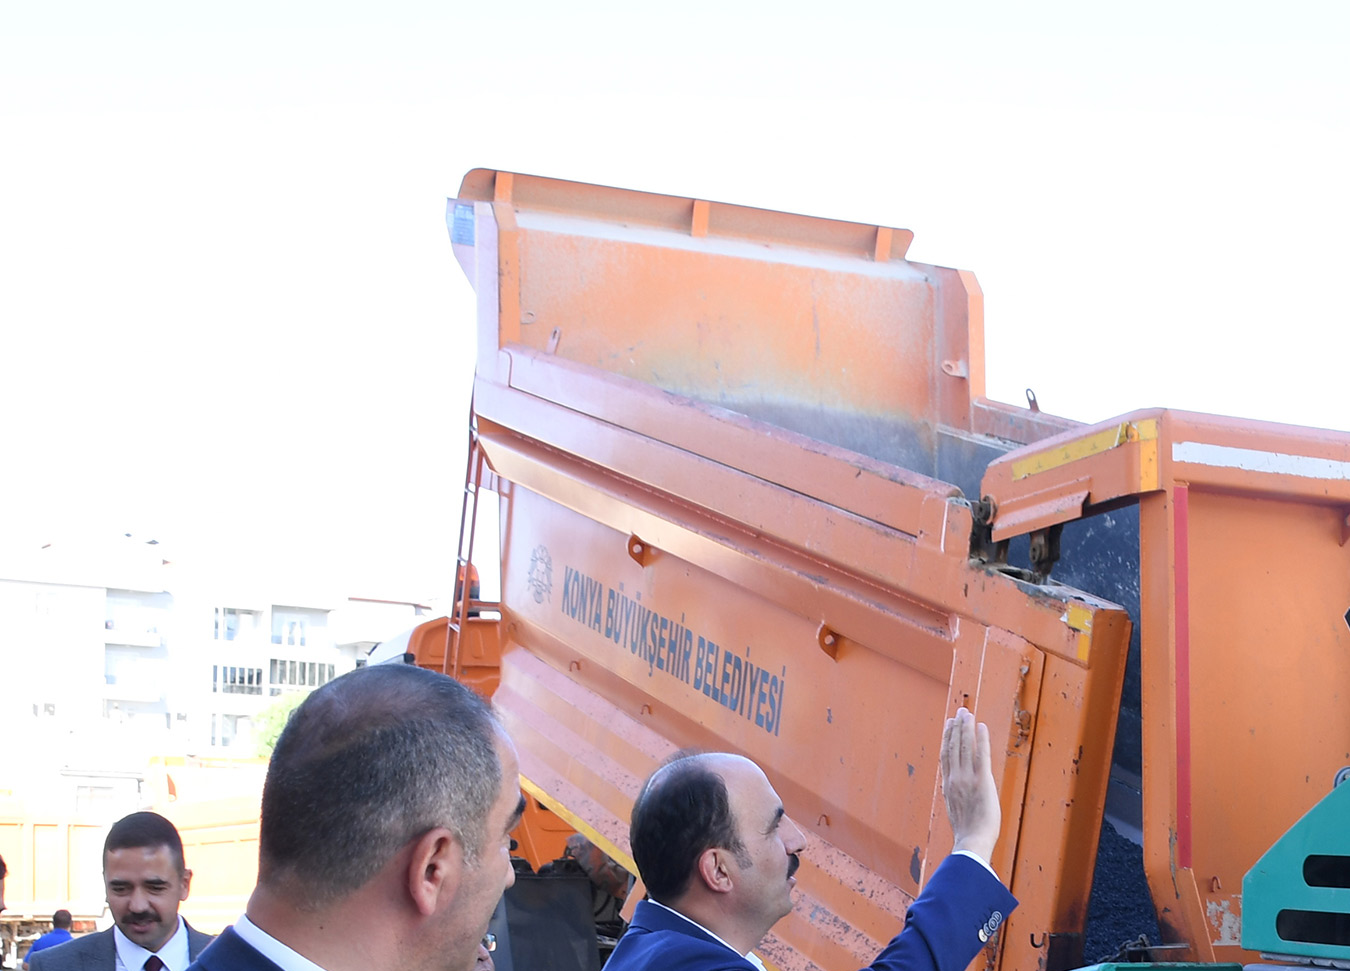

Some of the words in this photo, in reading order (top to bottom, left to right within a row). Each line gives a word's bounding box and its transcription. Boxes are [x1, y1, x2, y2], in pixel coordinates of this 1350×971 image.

[561, 565, 603, 634] KONYA
[604, 581, 693, 685] BÜYÜKŞEHİR
[693, 635, 786, 737] BELEDİYESİ
